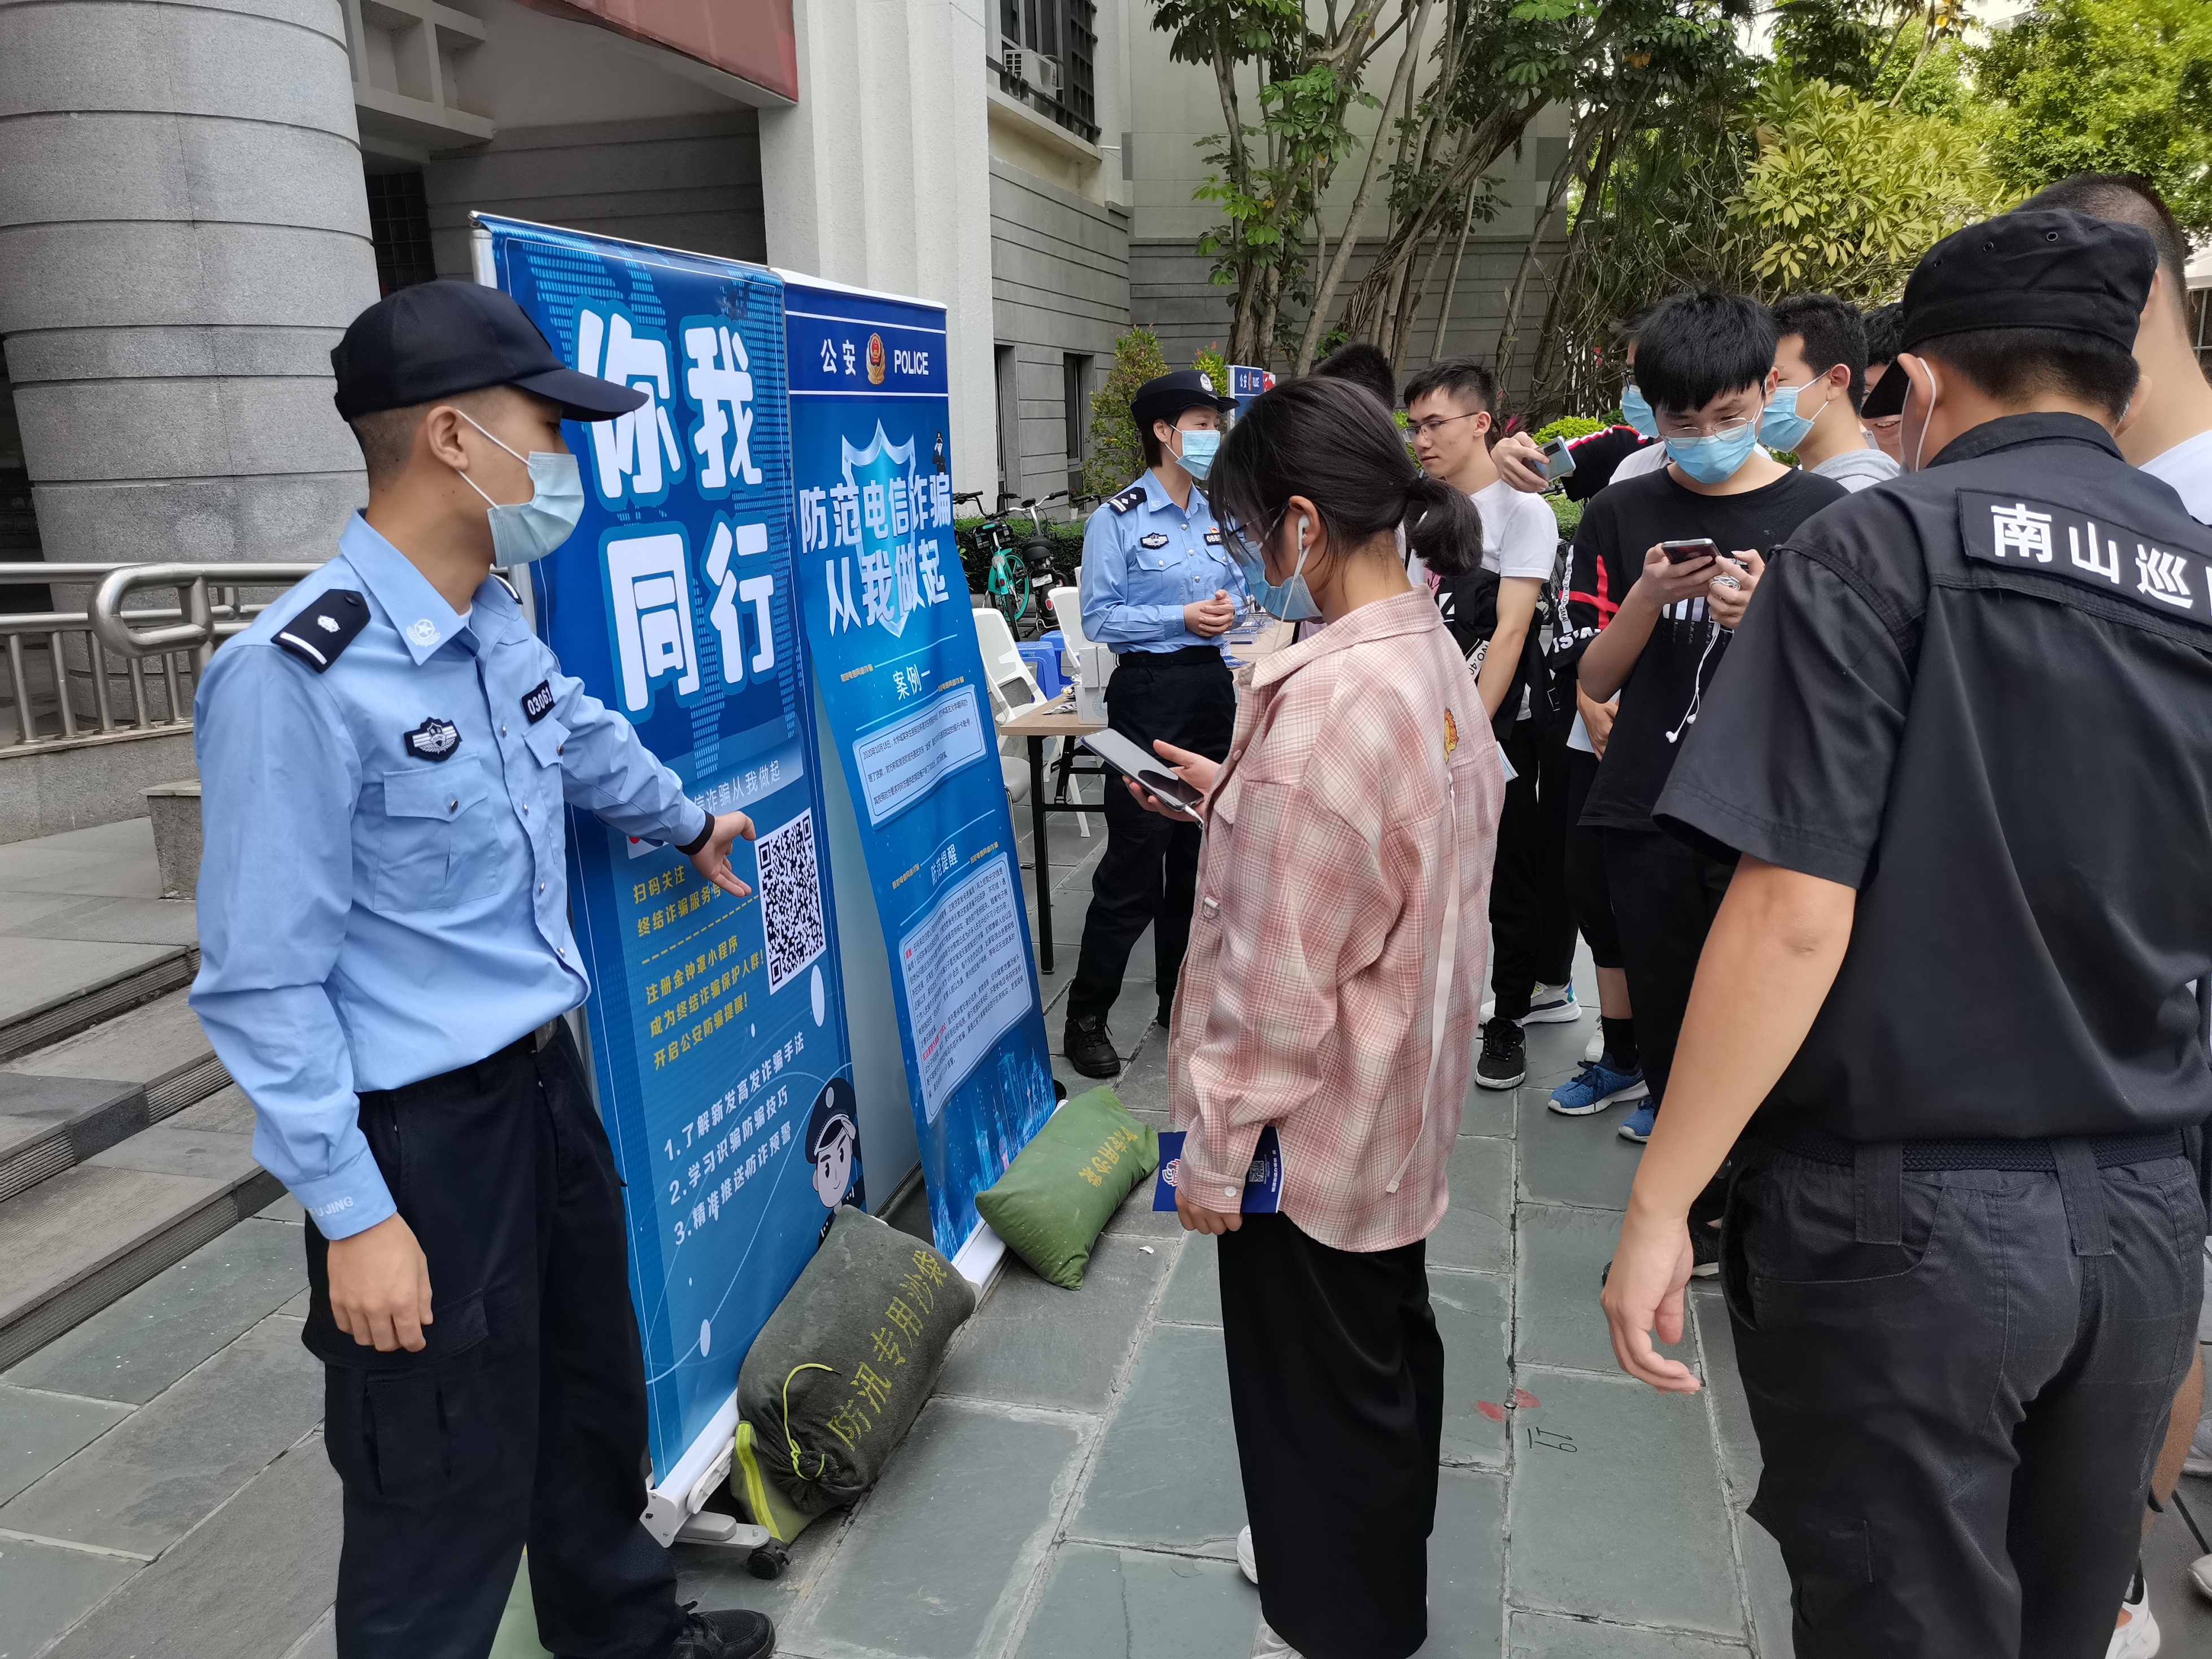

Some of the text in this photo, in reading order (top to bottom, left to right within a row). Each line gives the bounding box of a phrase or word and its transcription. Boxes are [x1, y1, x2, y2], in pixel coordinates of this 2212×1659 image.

[821, 339, 856, 376] 公安
[894, 350, 929, 375] POLICE
[578, 309, 762, 498] 你我
[799, 472, 951, 554] 防范电信诈骗
[826, 539, 949, 637] 从我做起
[1991, 503, 2212, 617] 南山巡
[607, 522, 774, 711] 同行
[527, 687, 552, 715] 03061
[892, 663, 931, 701] 案例一
[633, 865, 686, 904] 扫码关注
[931, 844, 958, 886] 防范提醒
[638, 882, 721, 937] 终结诈骗服务号
[645, 935, 738, 1005] 注册金钟罩小程序
[651, 949, 764, 1038] 成为终结诈骗保护人群!
[654, 992, 748, 1071] 开启公安防骗提醒!
[664, 1031, 804, 1161] 1.了解新发高发诈骗手法
[669, 1085, 788, 1206] 2.学习识骗防骗技巧
[674, 1120, 791, 1245] 3.精准推送防诈预警
[827, 1250, 947, 1452] 防汛专用沙袋
